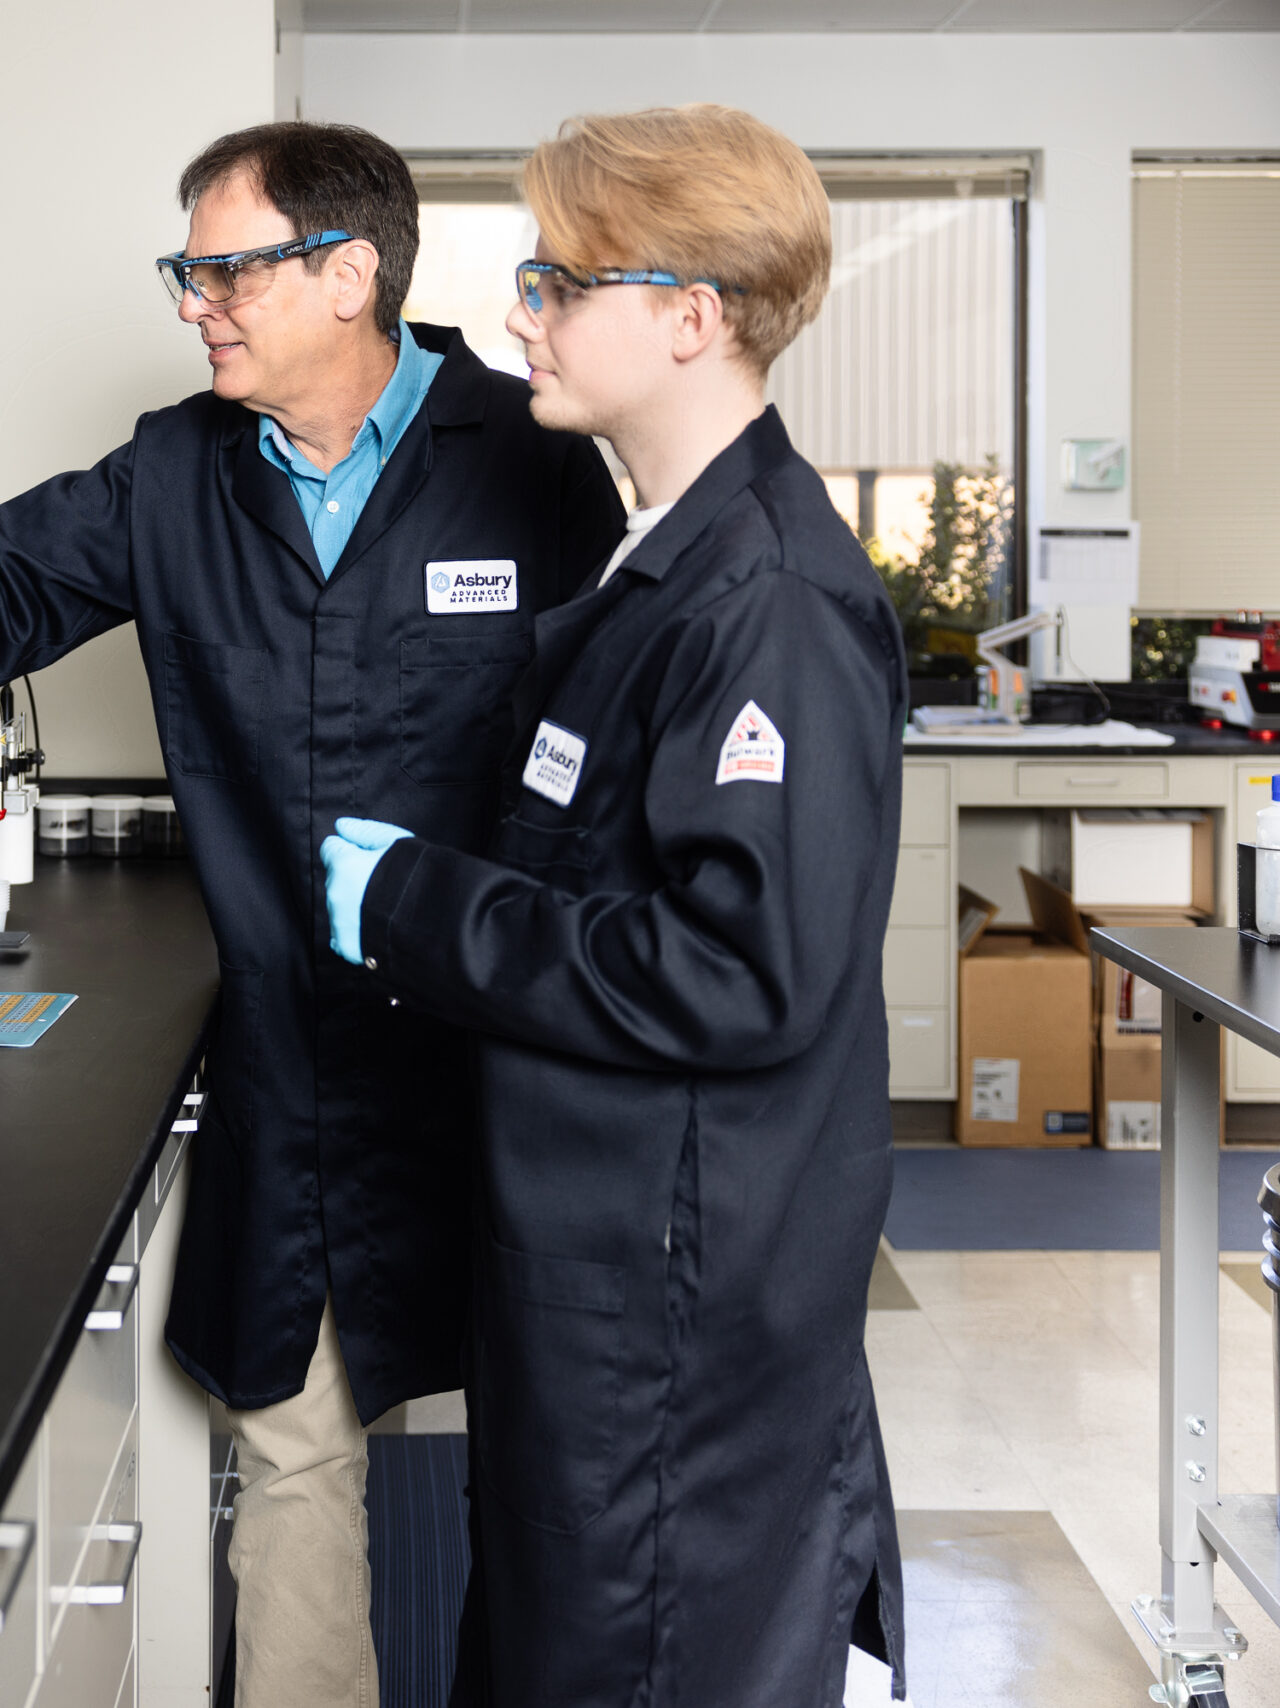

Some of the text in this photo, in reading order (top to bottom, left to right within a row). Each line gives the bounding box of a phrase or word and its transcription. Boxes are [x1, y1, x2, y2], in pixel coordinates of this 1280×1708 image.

[454, 573, 512, 589] Asbury
[451, 589, 506, 597] ADVANCED
[547, 745, 577, 776] Asbury
